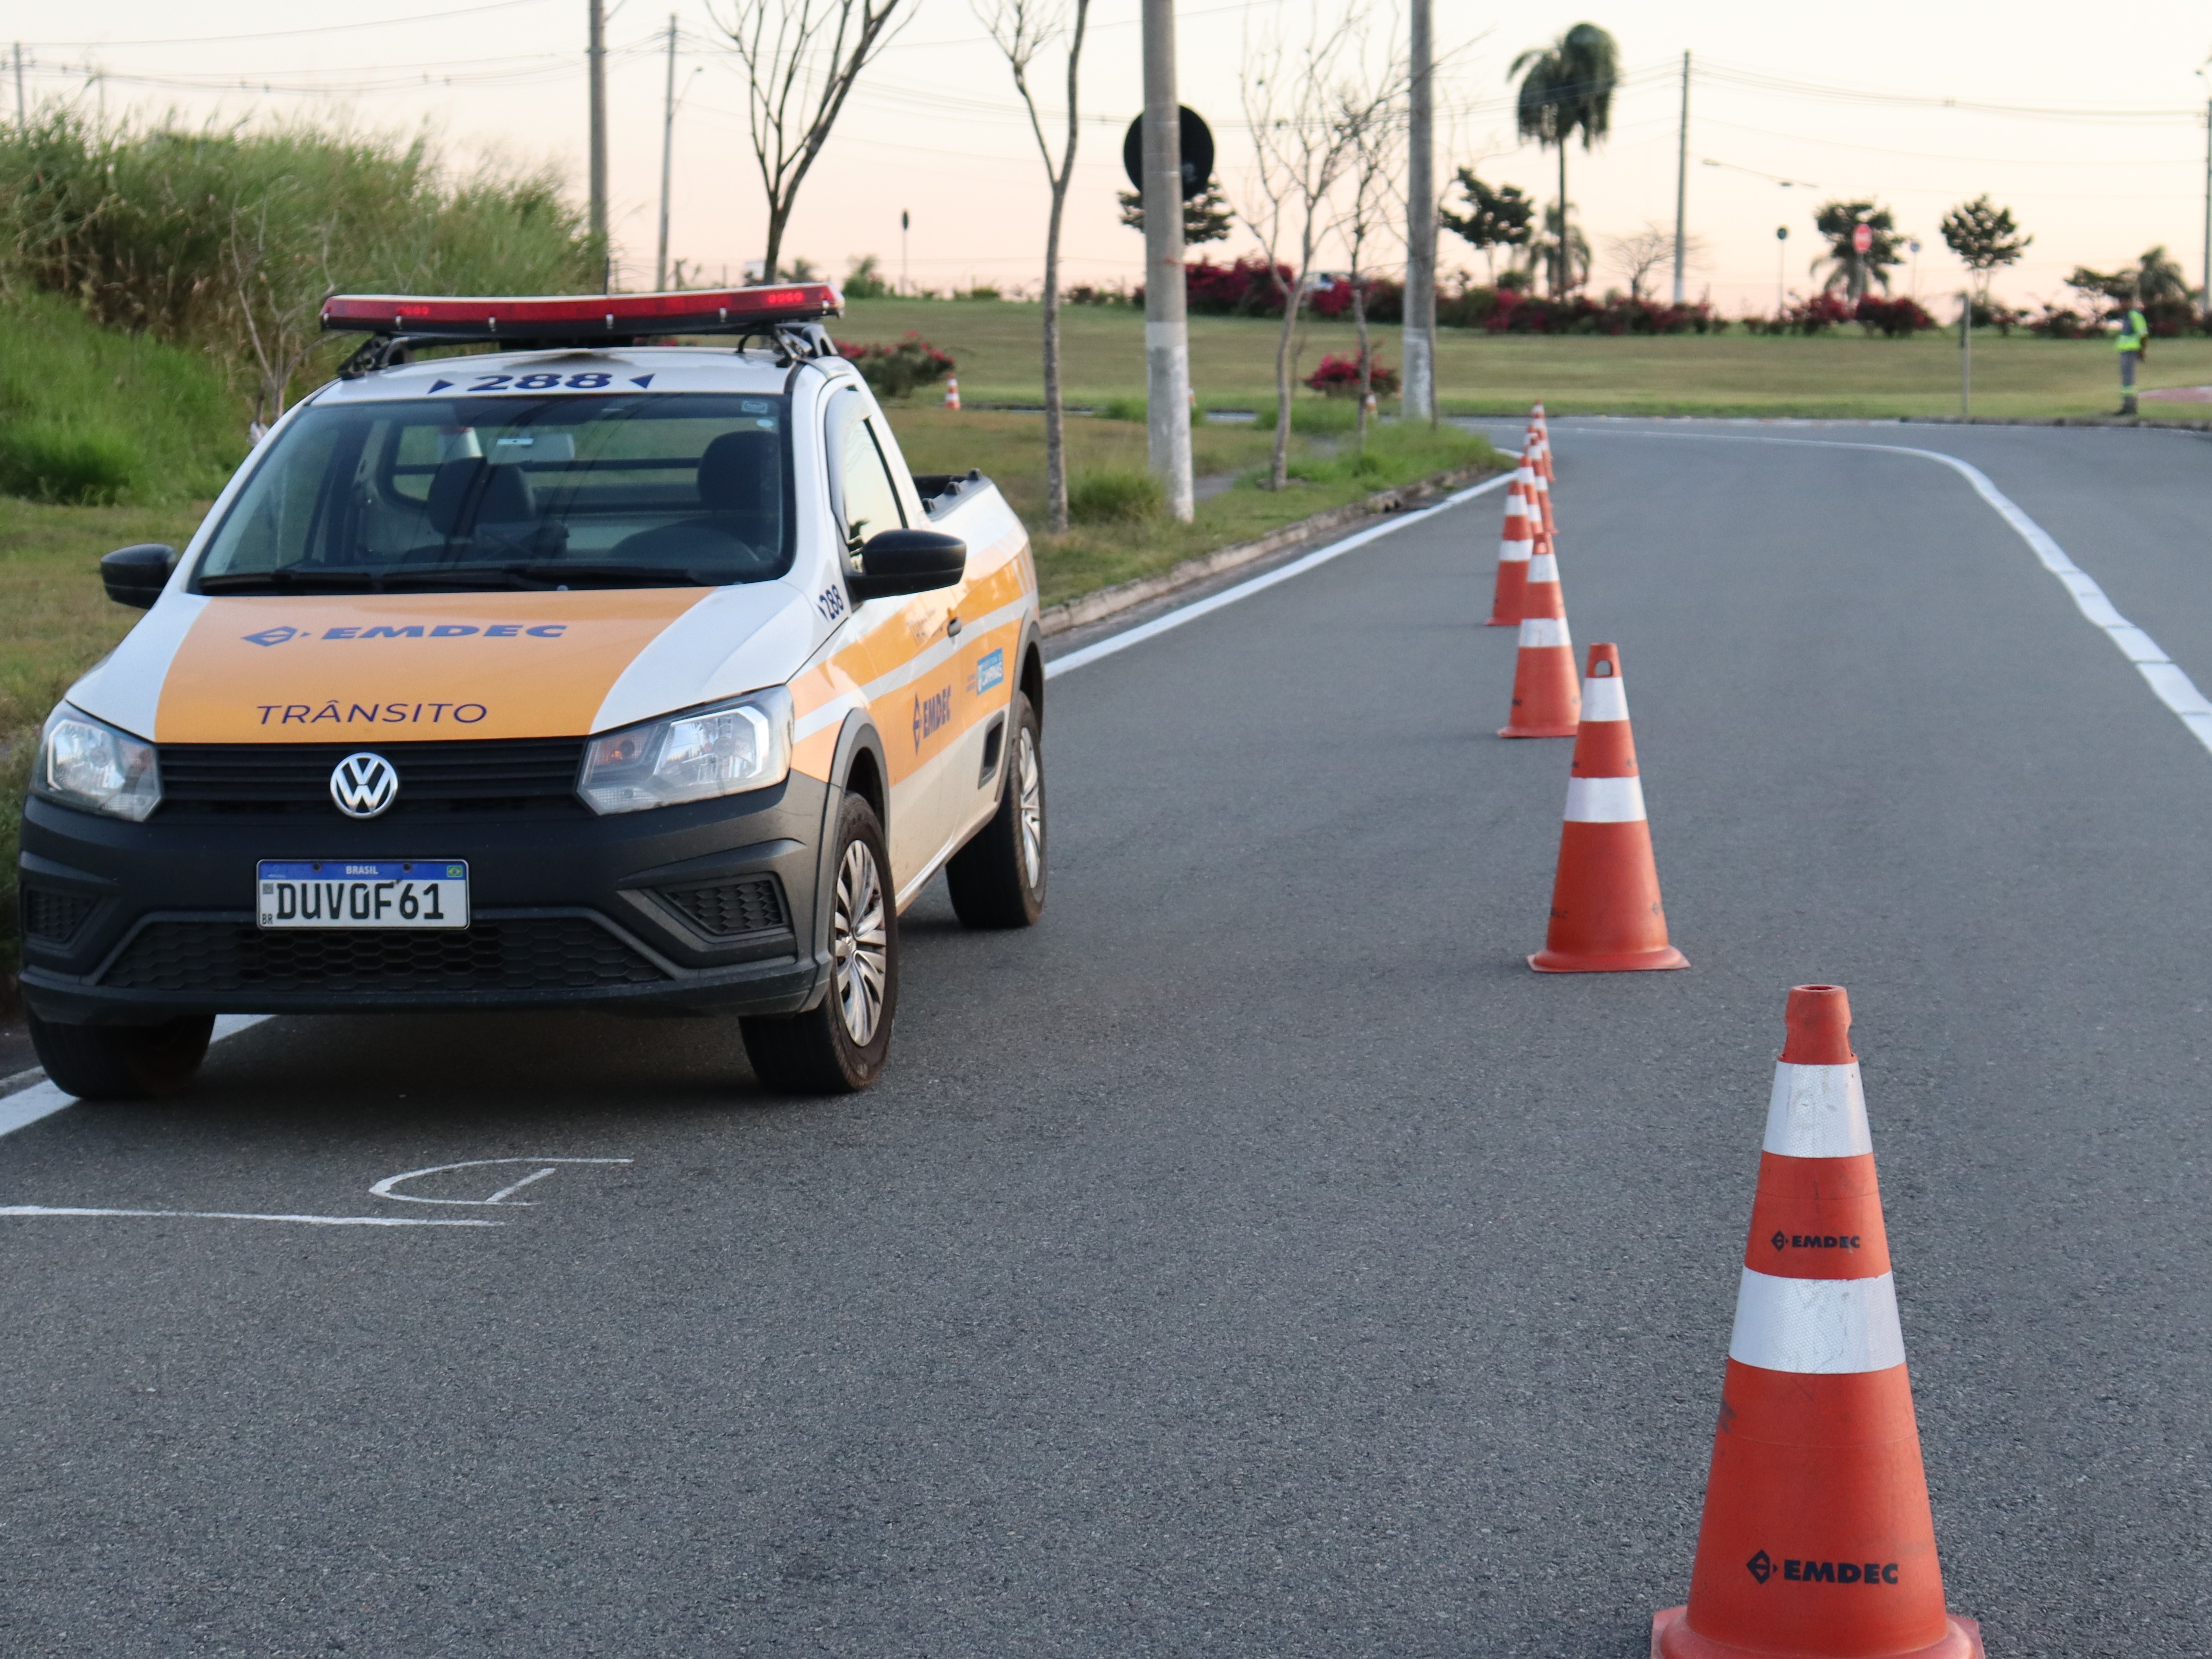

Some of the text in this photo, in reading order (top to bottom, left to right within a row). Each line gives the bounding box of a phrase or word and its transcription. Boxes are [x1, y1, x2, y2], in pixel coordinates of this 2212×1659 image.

[467, 372, 613, 392] 288
[819, 584, 844, 620] 288
[321, 624, 568, 639] EMDEC
[257, 700, 487, 725] TRÂNSITO
[330, 752, 398, 819] VW
[346, 865, 379, 875] BRASIL
[262, 913, 273, 925] BR
[1792, 1235, 1861, 1249] EMDEC
[1784, 1559, 1899, 1585] EMDEC
